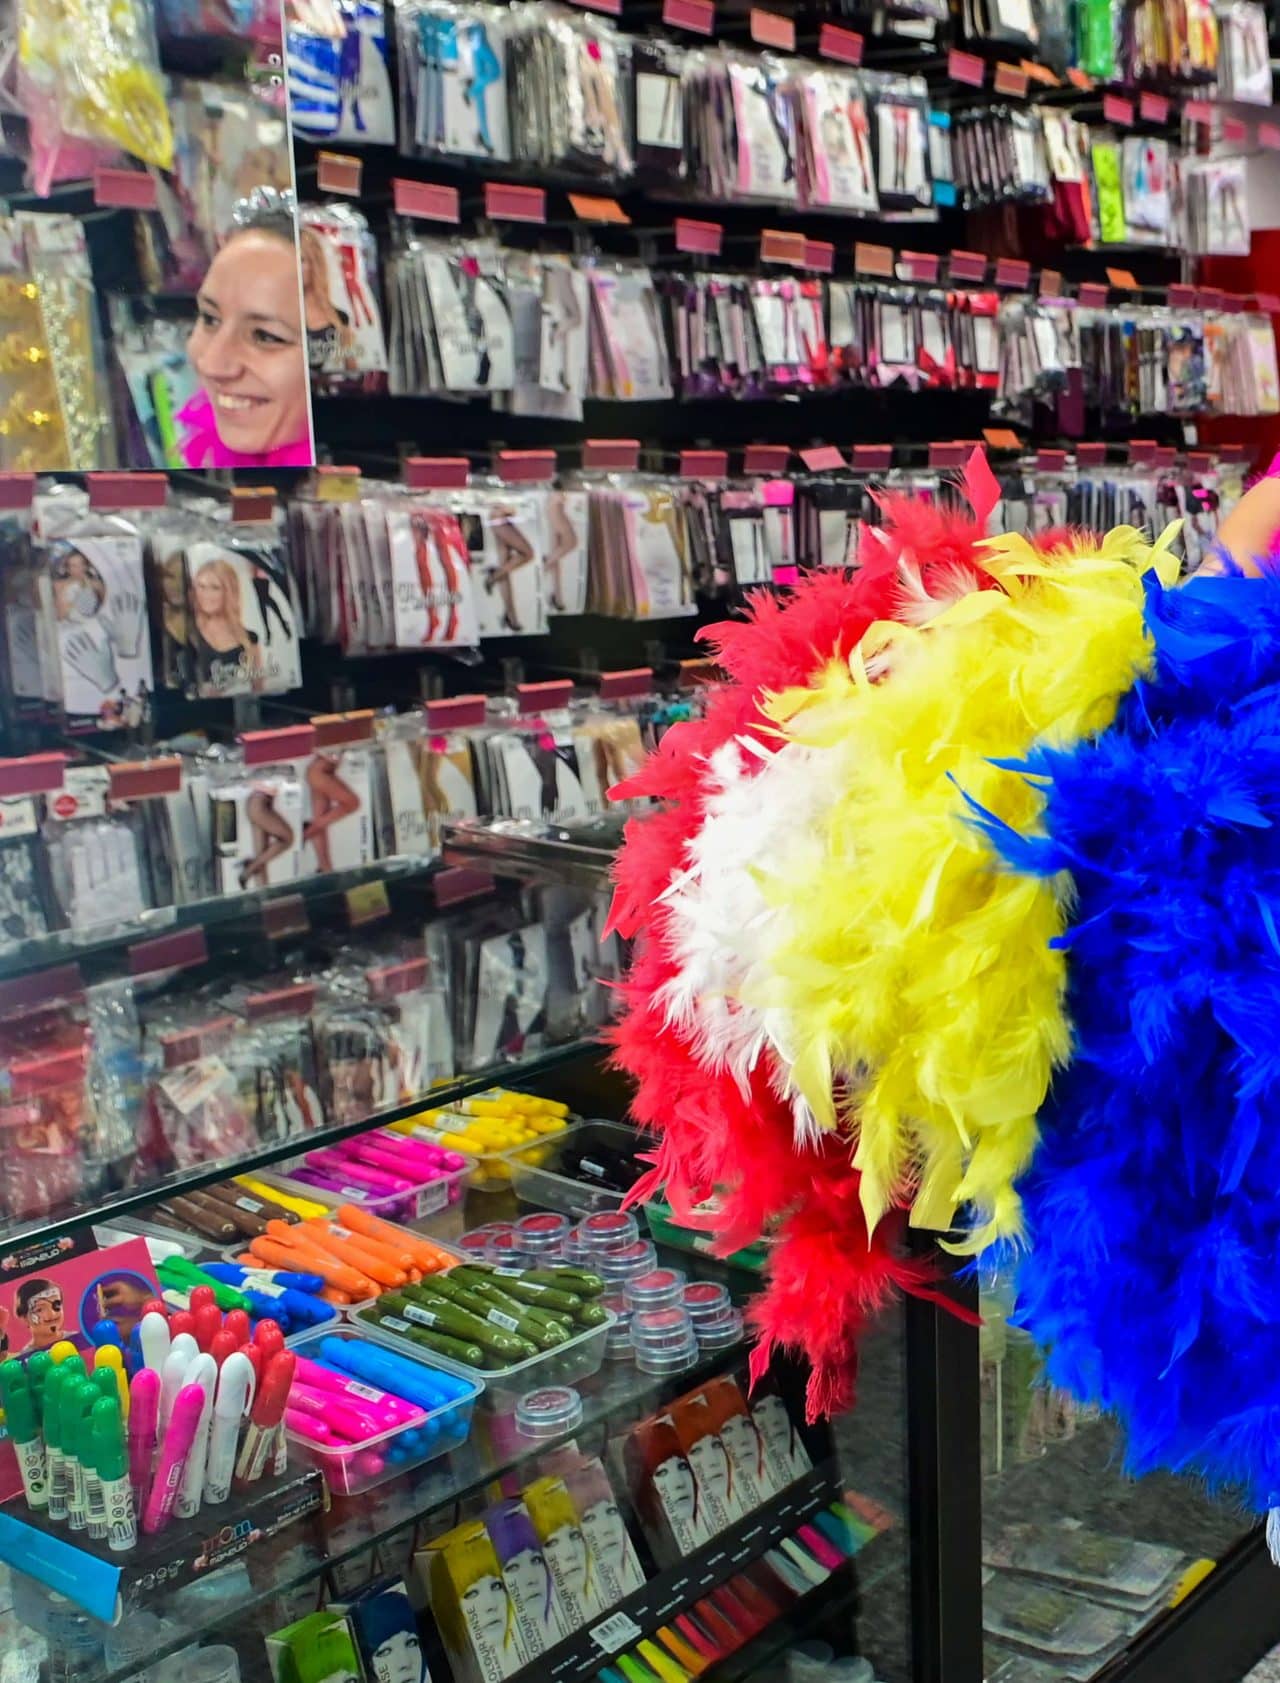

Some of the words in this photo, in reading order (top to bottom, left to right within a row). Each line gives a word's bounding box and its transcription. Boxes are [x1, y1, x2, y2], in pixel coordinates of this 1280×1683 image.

[547, 1553, 565, 1587] RINSE
[507, 1578, 526, 1613] RINSE
[465, 1604, 483, 1641] RINSE
[476, 1639, 499, 1683] OLOUR
